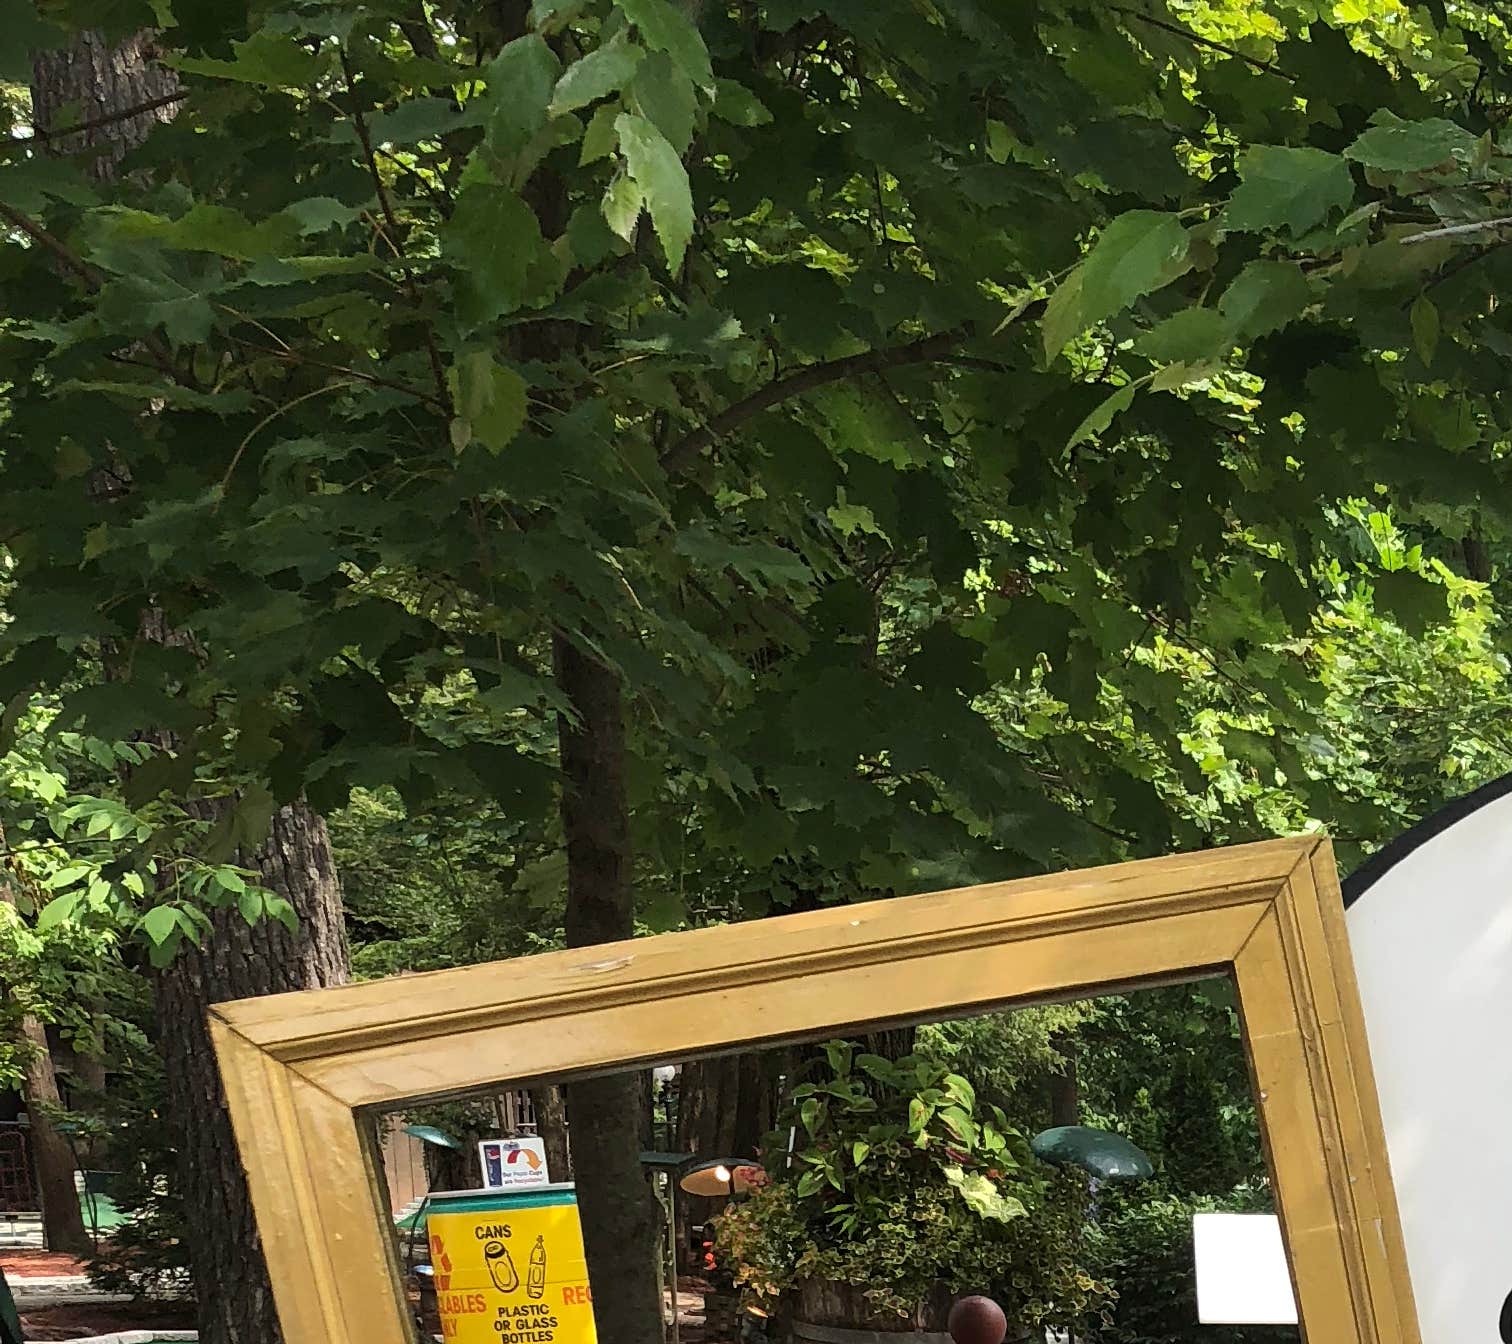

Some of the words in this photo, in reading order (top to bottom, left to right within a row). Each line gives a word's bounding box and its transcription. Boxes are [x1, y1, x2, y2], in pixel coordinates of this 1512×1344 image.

[475, 1225, 512, 1239] CANS
[498, 1304, 550, 1318] PLASTIC
[494, 1320, 511, 1331] OR
[515, 1317, 558, 1330] GLASS
[502, 1331, 553, 1344] BOTTLES
